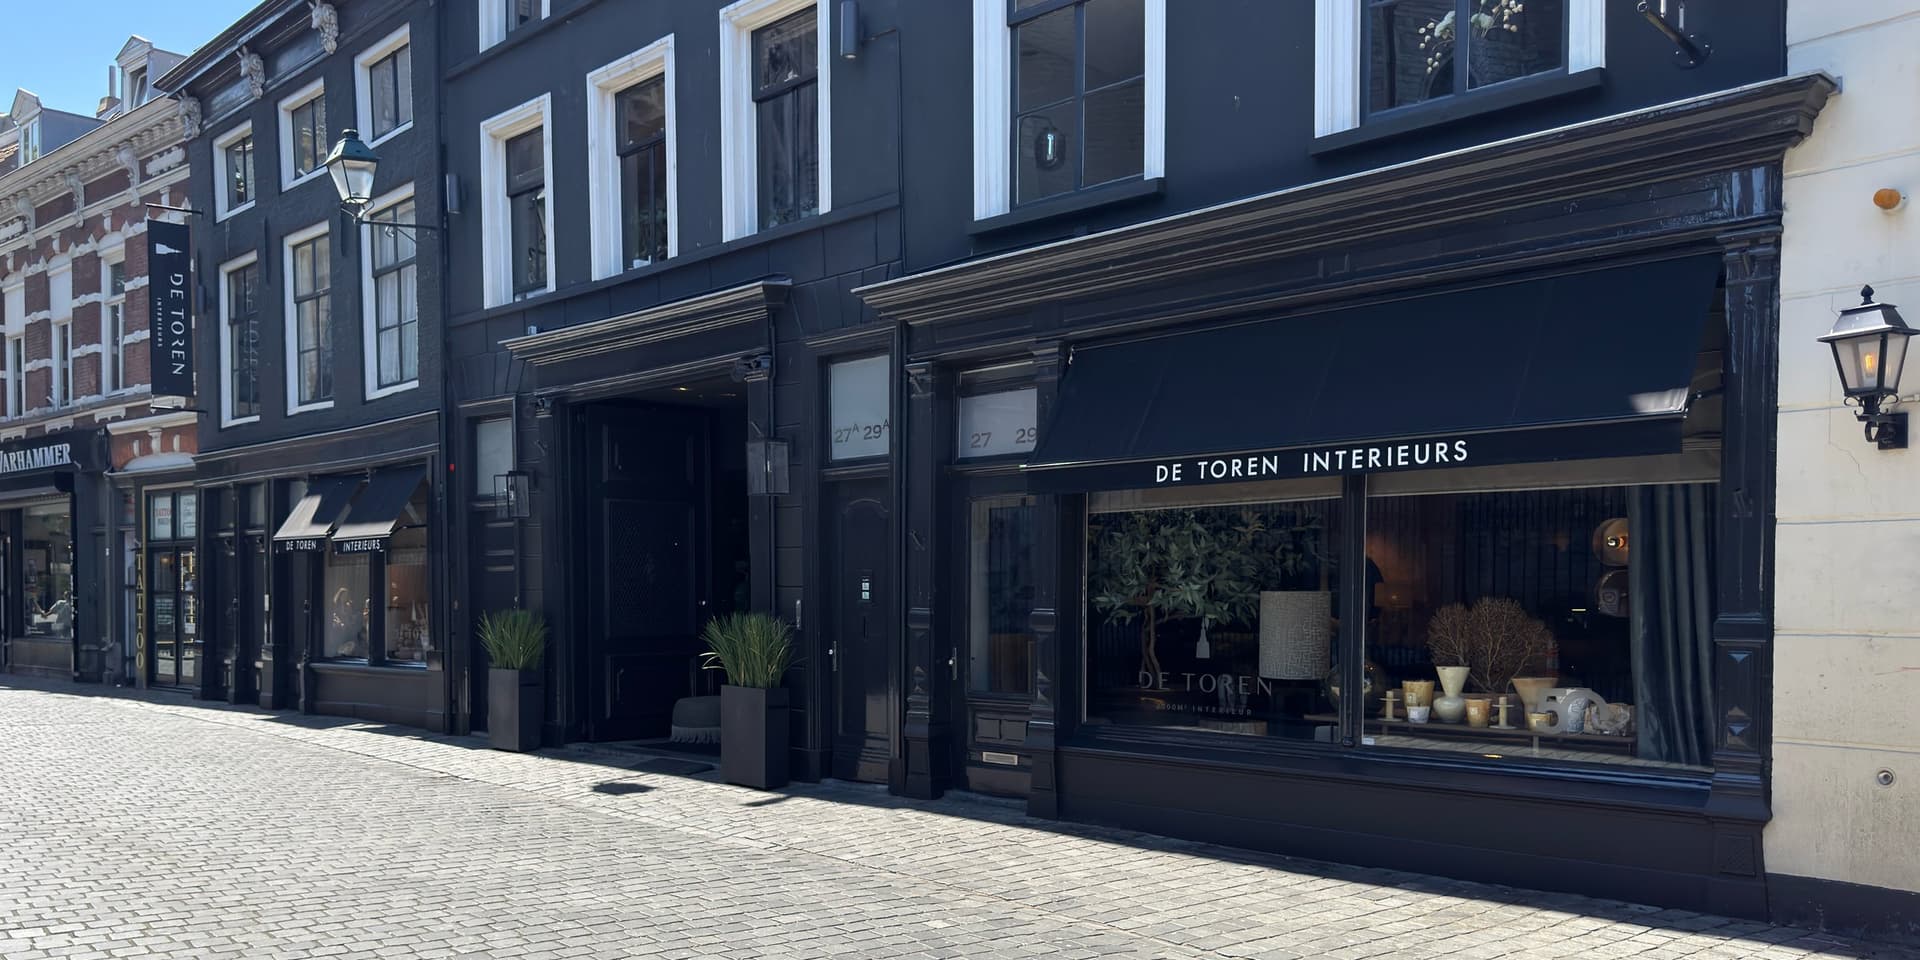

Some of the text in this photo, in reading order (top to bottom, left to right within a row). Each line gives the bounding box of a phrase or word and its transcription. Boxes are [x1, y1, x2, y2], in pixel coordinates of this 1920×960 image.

[170, 273, 185, 375] DE TOREN
[970, 427, 1037, 449] 27 29
[1156, 440, 1468, 483] DE TOREN INTERIEURS
[286, 539, 381, 552] DE TOREN INTERIEURS
[135, 553, 144, 669] TATTOO
[1138, 671, 1273, 697] DE TOREN
